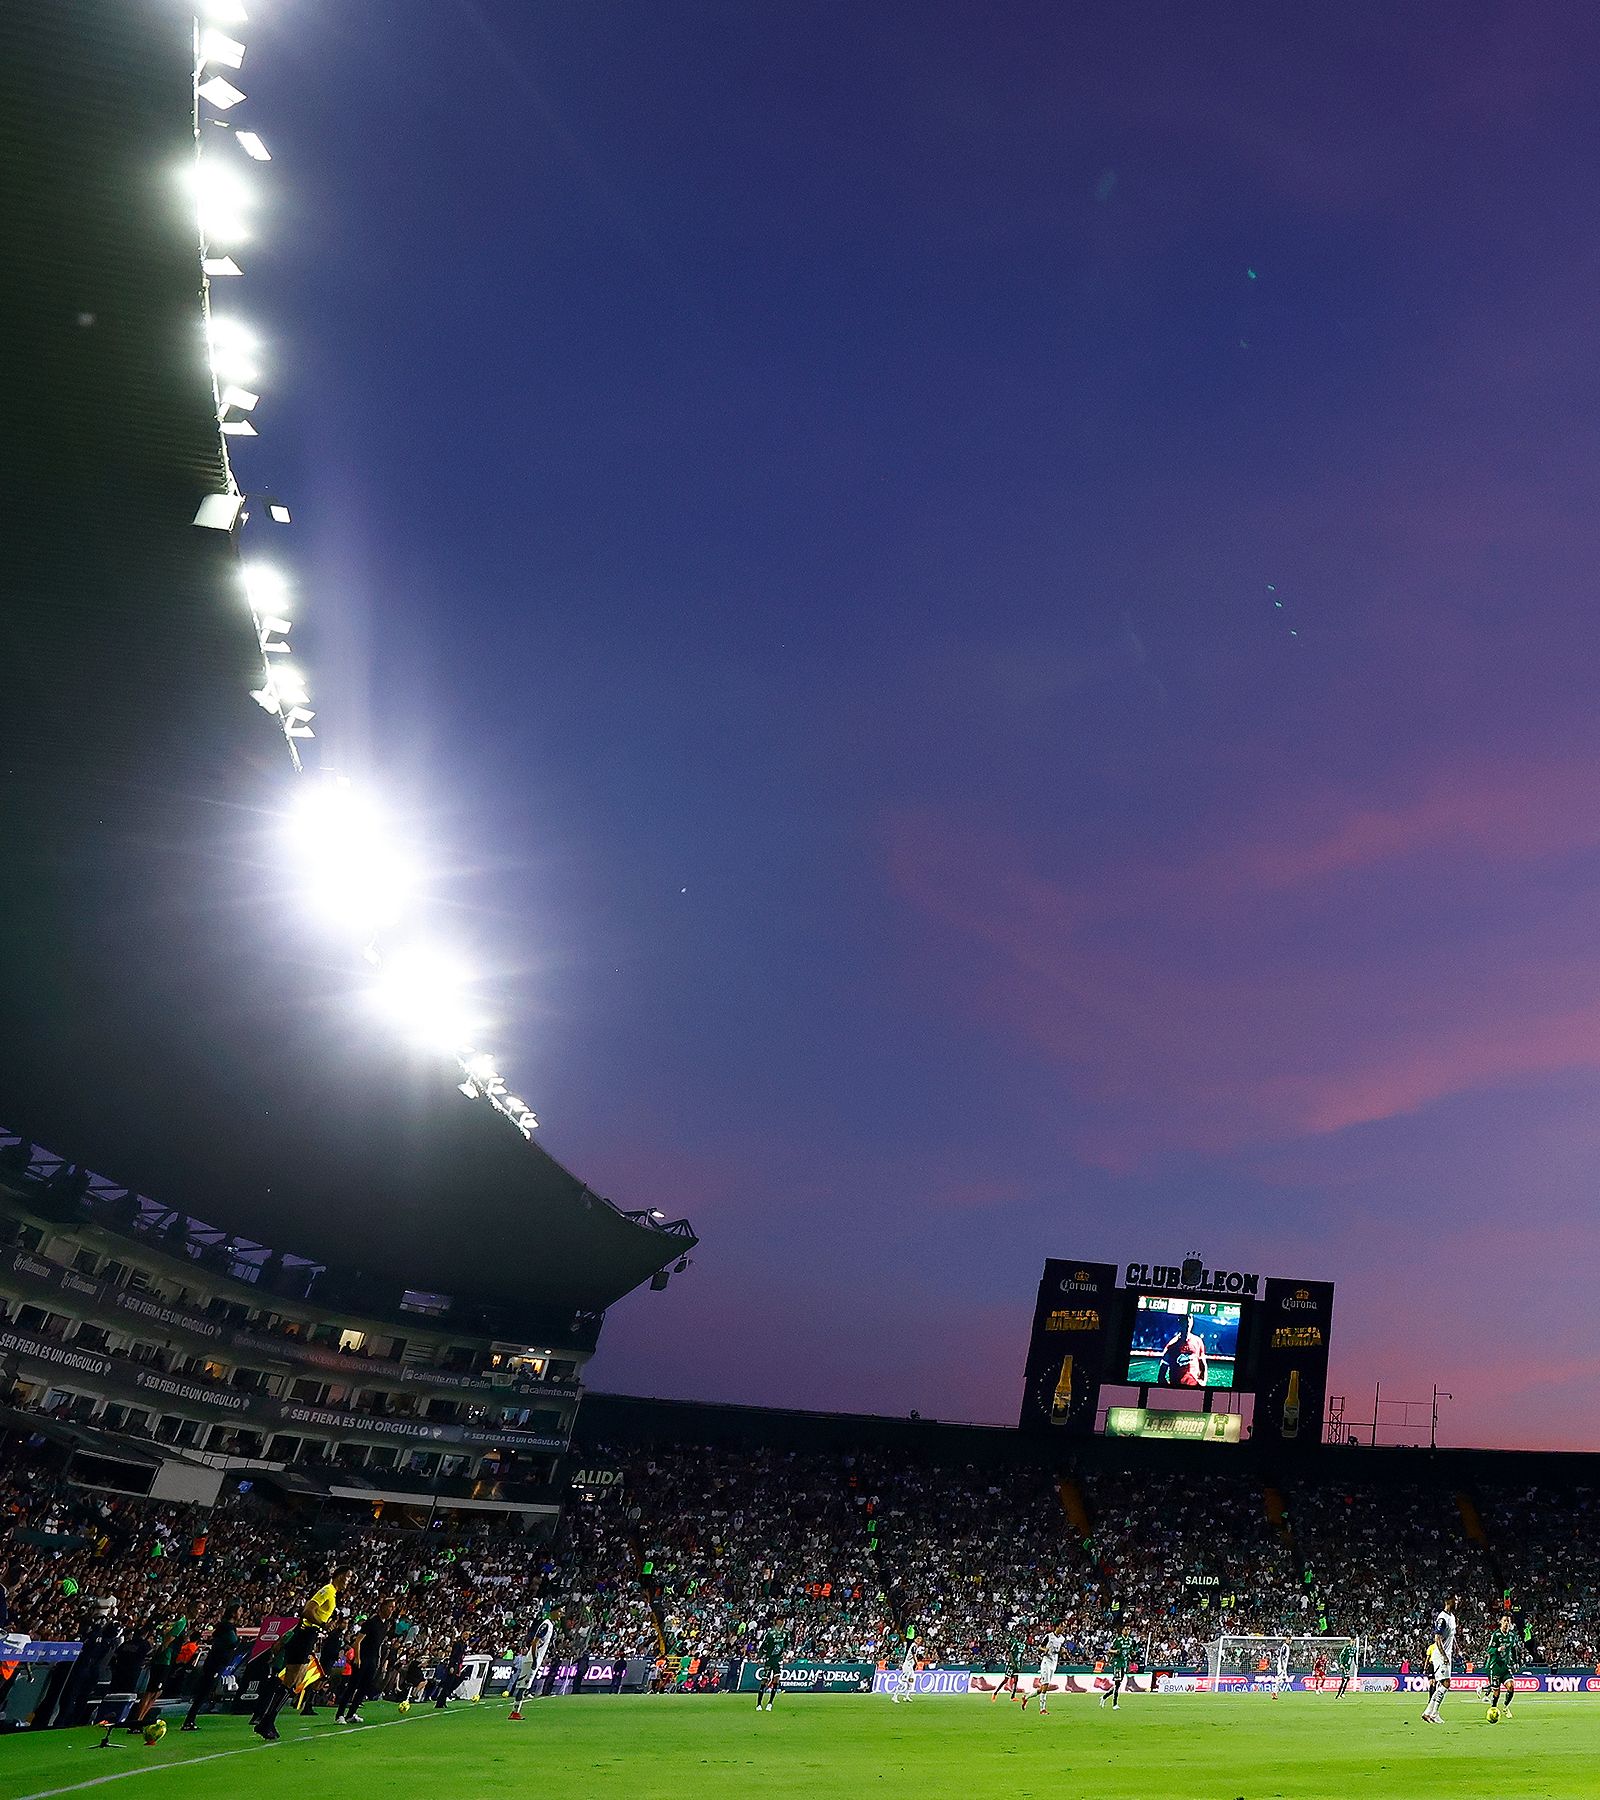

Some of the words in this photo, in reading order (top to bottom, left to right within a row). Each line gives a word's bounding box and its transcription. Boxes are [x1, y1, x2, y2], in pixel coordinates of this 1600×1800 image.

[1060, 1278, 1099, 1294] Corona
[1126, 1263, 1181, 1288] CLUB
[1201, 1269, 1260, 1295] LEON
[1281, 1297, 1318, 1311] Corona
[0, 1332, 17, 1349] SER
[16, 1338, 41, 1356] FIERA
[39, 1345, 52, 1359] ES
[50, 1348, 66, 1363] UN
[64, 1352, 103, 1373] ORGULLO
[413, 1371, 459, 1386] caliente.mx
[144, 1375, 160, 1390] SER
[159, 1380, 181, 1396] FIERA
[180, 1385, 190, 1398] ES
[189, 1388, 203, 1401] UN
[202, 1391, 240, 1409] ORGULLO
[529, 1386, 577, 1399] caliente.mx
[291, 1408, 310, 1421] SER
[310, 1412, 341, 1426] FIERA
[342, 1416, 356, 1428] ES
[356, 1418, 374, 1430] UN
[374, 1421, 429, 1437] ORGULLO
[1160, 1419, 1206, 1433] GUARIDA
[527, 1438, 560, 1447] ORGULLO
[574, 1469, 625, 1485] ALIDA
[1185, 1575, 1220, 1586] SALIDA
[755, 1667, 808, 1681] CDAD
[1545, 1677, 1581, 1691] TONY
